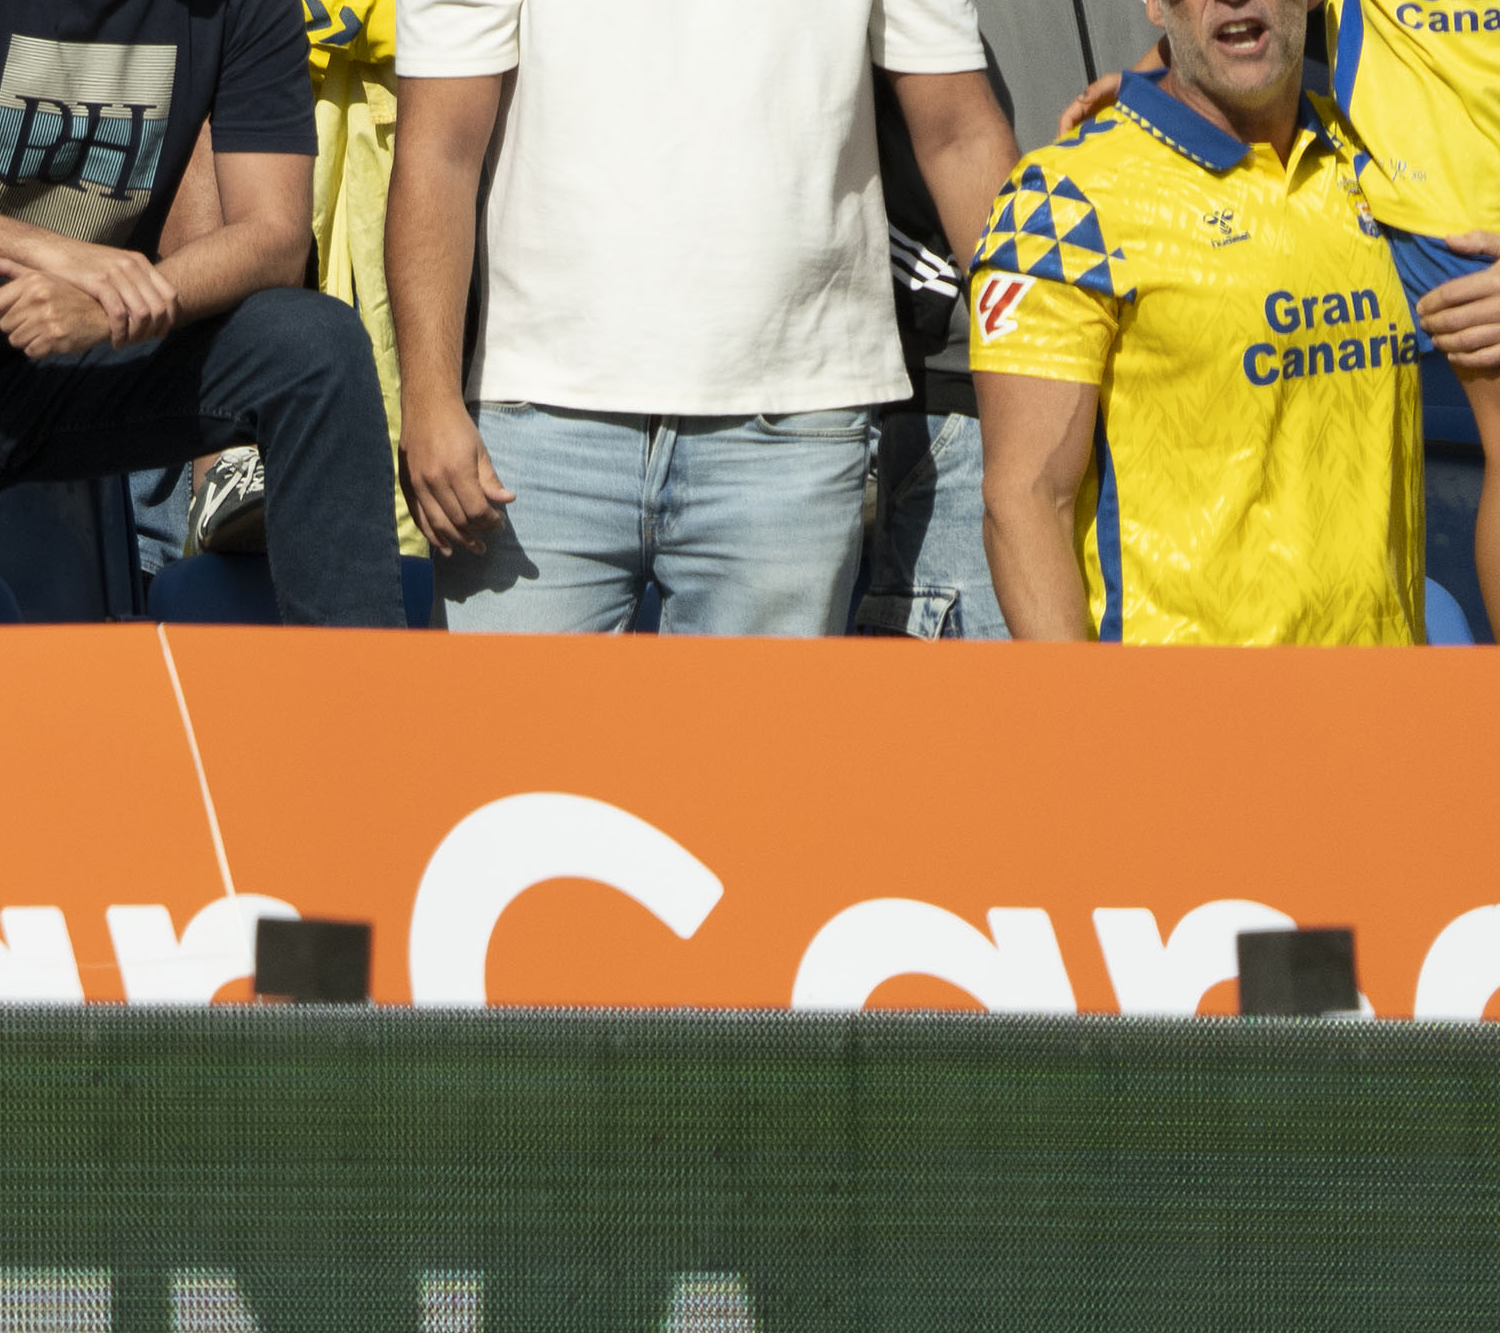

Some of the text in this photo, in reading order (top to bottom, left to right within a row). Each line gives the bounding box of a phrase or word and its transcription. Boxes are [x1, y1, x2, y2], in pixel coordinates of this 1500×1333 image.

[1395, 1, 1500, 34] Cana
[1264, 287, 1381, 335] Gran
[1241, 323, 1422, 387] Canaria
